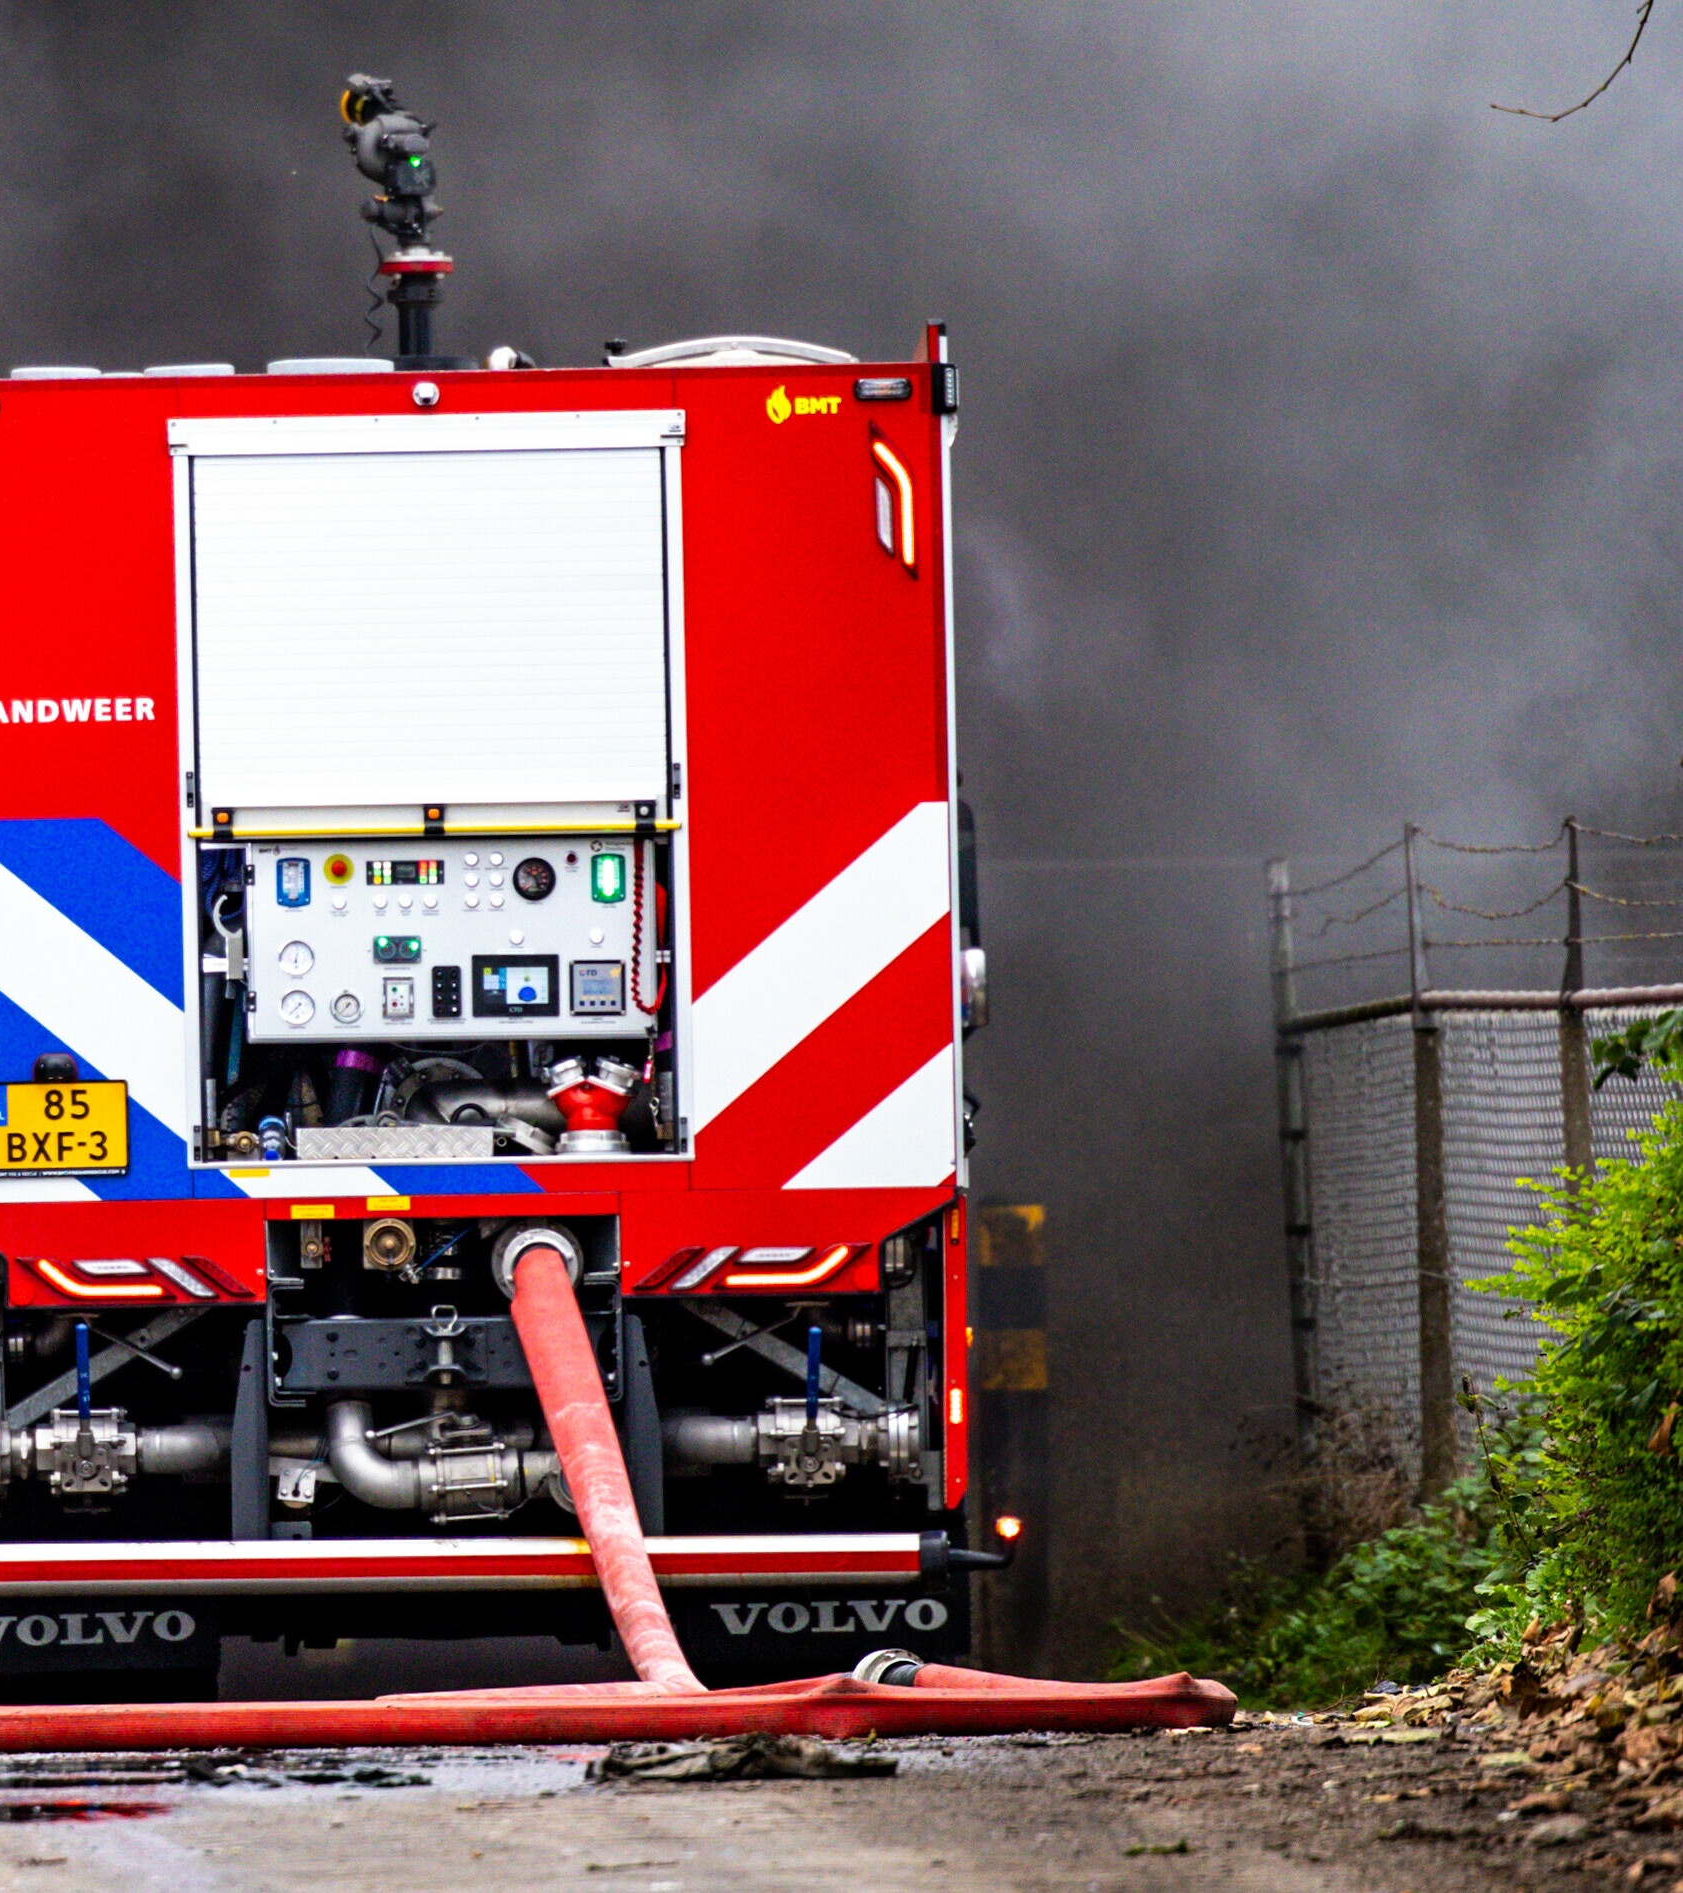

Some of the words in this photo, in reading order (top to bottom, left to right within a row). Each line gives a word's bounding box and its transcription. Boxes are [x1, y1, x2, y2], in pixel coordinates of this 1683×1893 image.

[794, 396, 842, 415] BMT
[44, 1089, 90, 1120] 85
[7, 1130, 108, 1163] BXF-3
[711, 1598, 948, 1635] VOLVO
